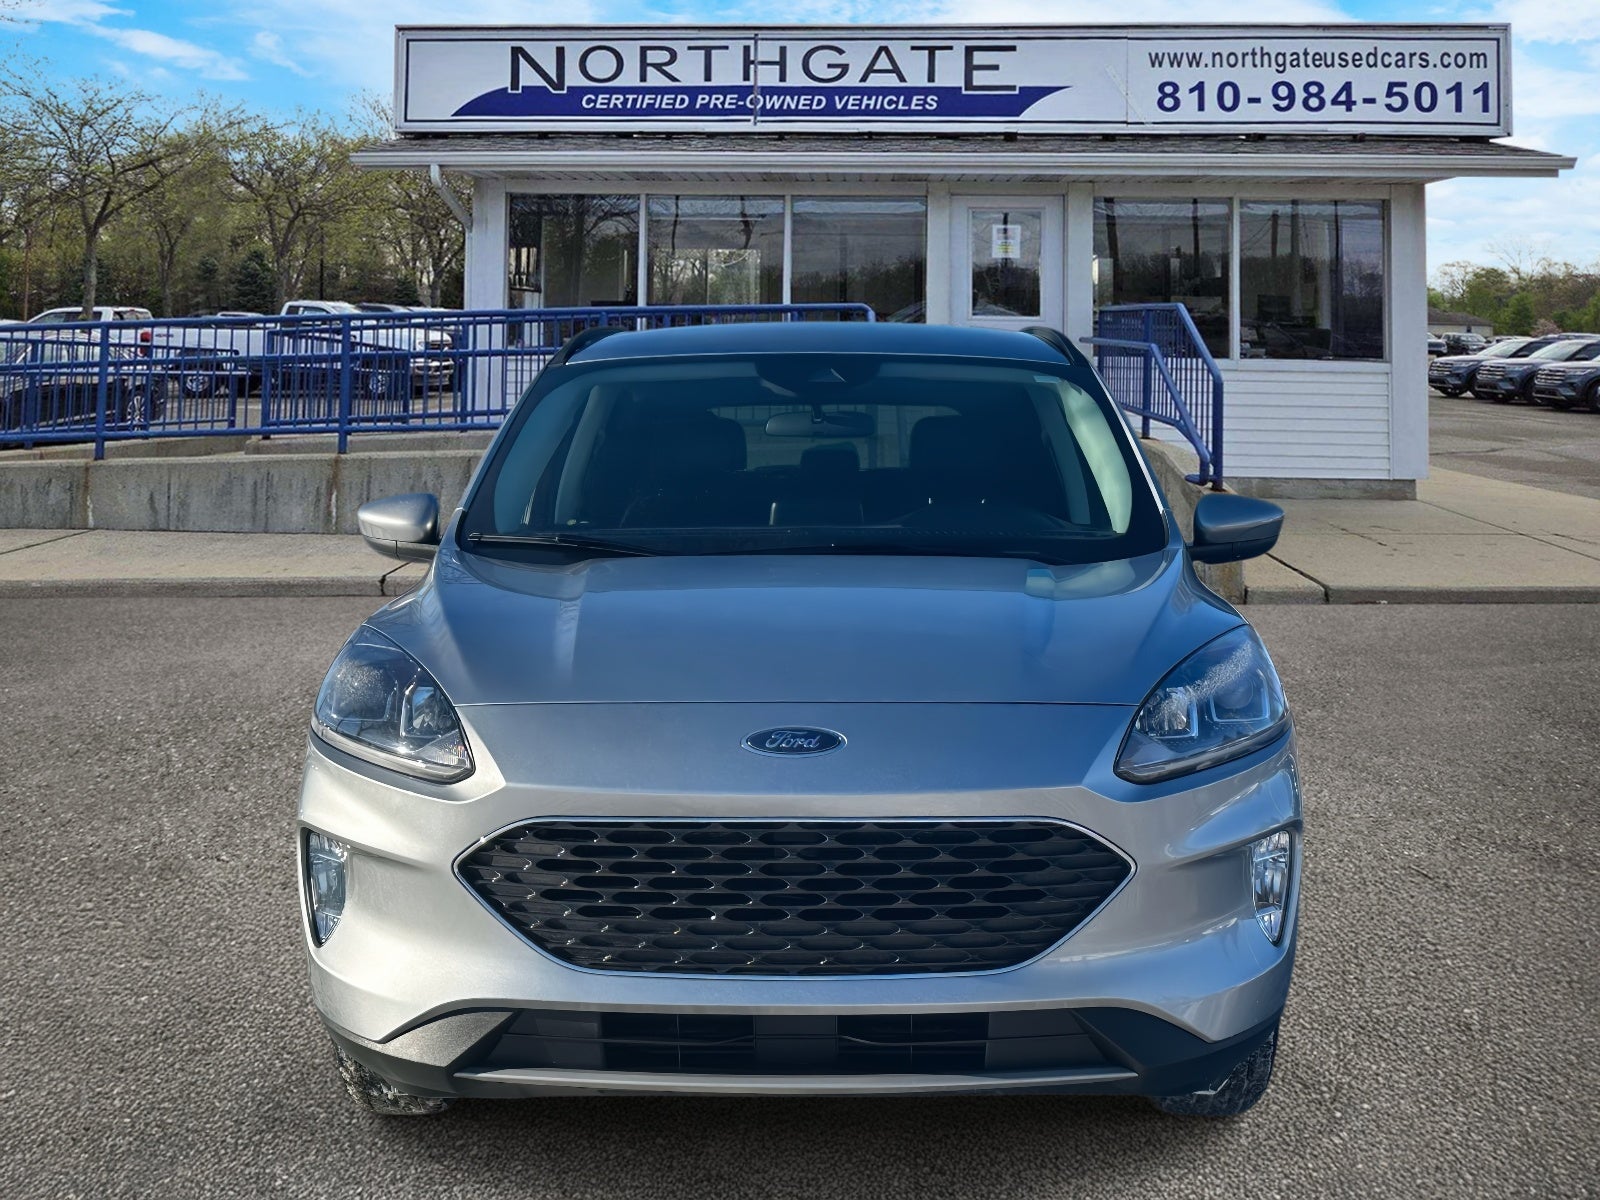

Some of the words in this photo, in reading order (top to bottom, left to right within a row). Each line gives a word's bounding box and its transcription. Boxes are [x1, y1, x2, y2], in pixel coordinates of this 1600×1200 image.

[510, 45, 1017, 92] NORTHGATE
[1148, 47, 1488, 73] www.northgateusedcars.com
[581, 94, 689, 109] CERTIFIED
[695, 95, 826, 110] PRE-OWNED
[834, 95, 938, 110] VEHICLES
[1156, 80, 1490, 112] 810-984-5011
[765, 730, 820, 749] Ford
